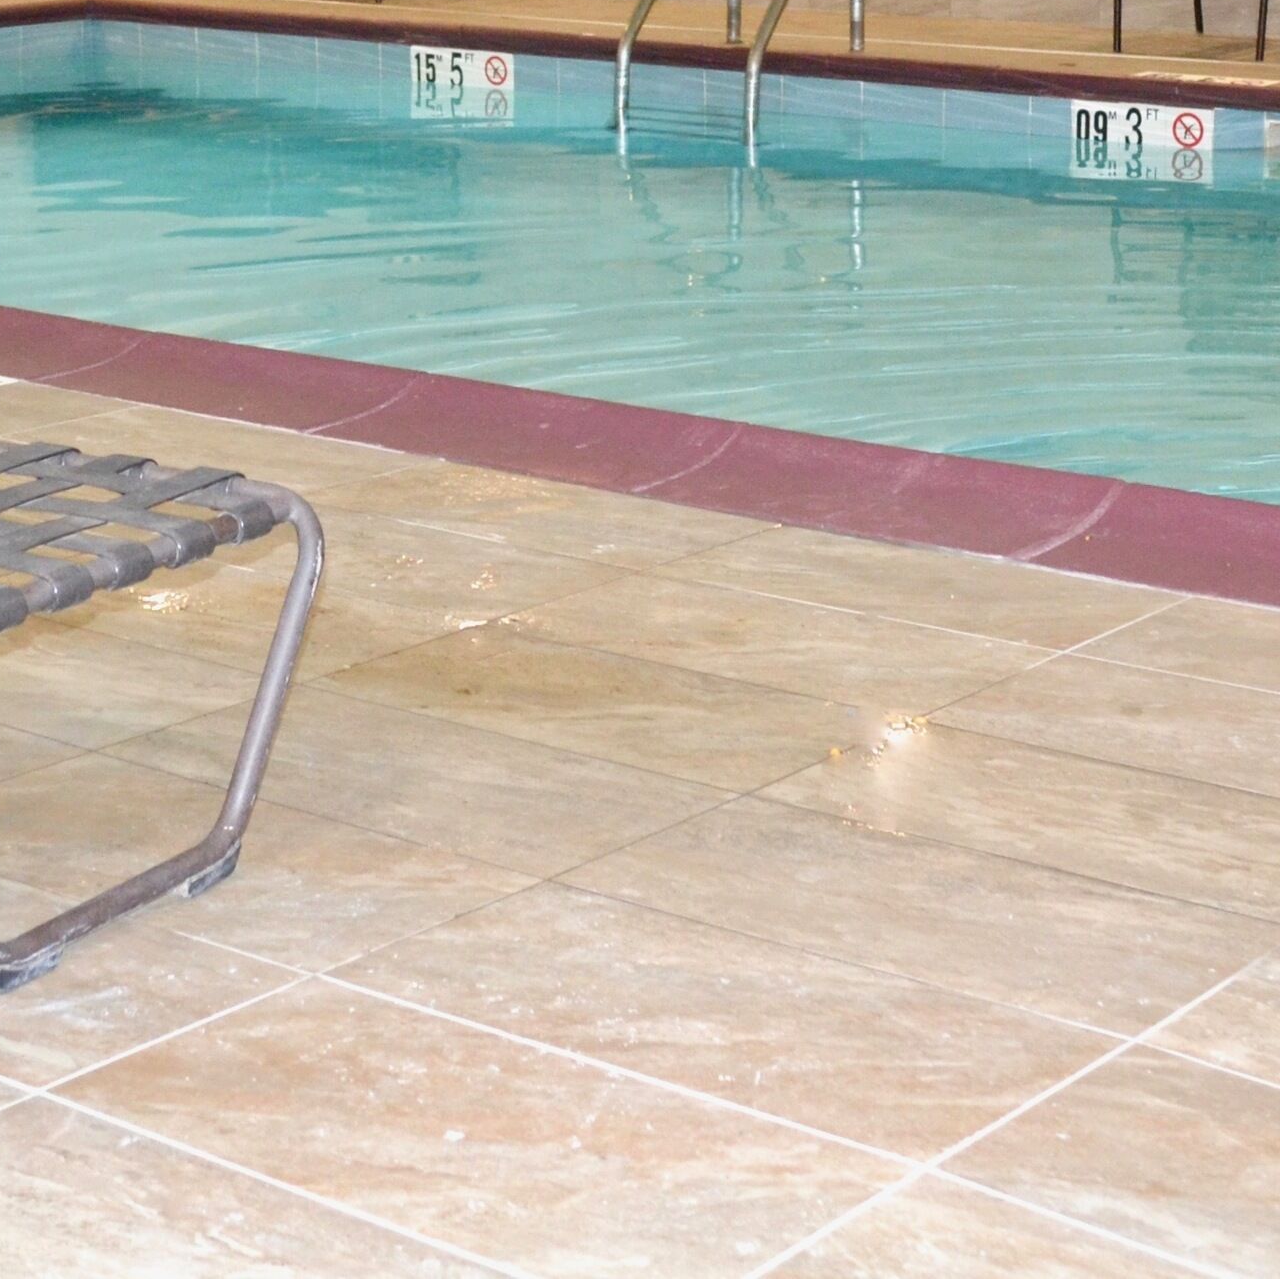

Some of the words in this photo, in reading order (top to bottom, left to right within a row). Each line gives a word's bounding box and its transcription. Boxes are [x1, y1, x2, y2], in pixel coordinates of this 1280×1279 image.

[450, 51, 464, 87] 5
[464, 52, 475, 63] FT
[1108, 110, 1118, 121] M
[1125, 106, 1144, 145] 3
[1146, 107, 1160, 122] FT
